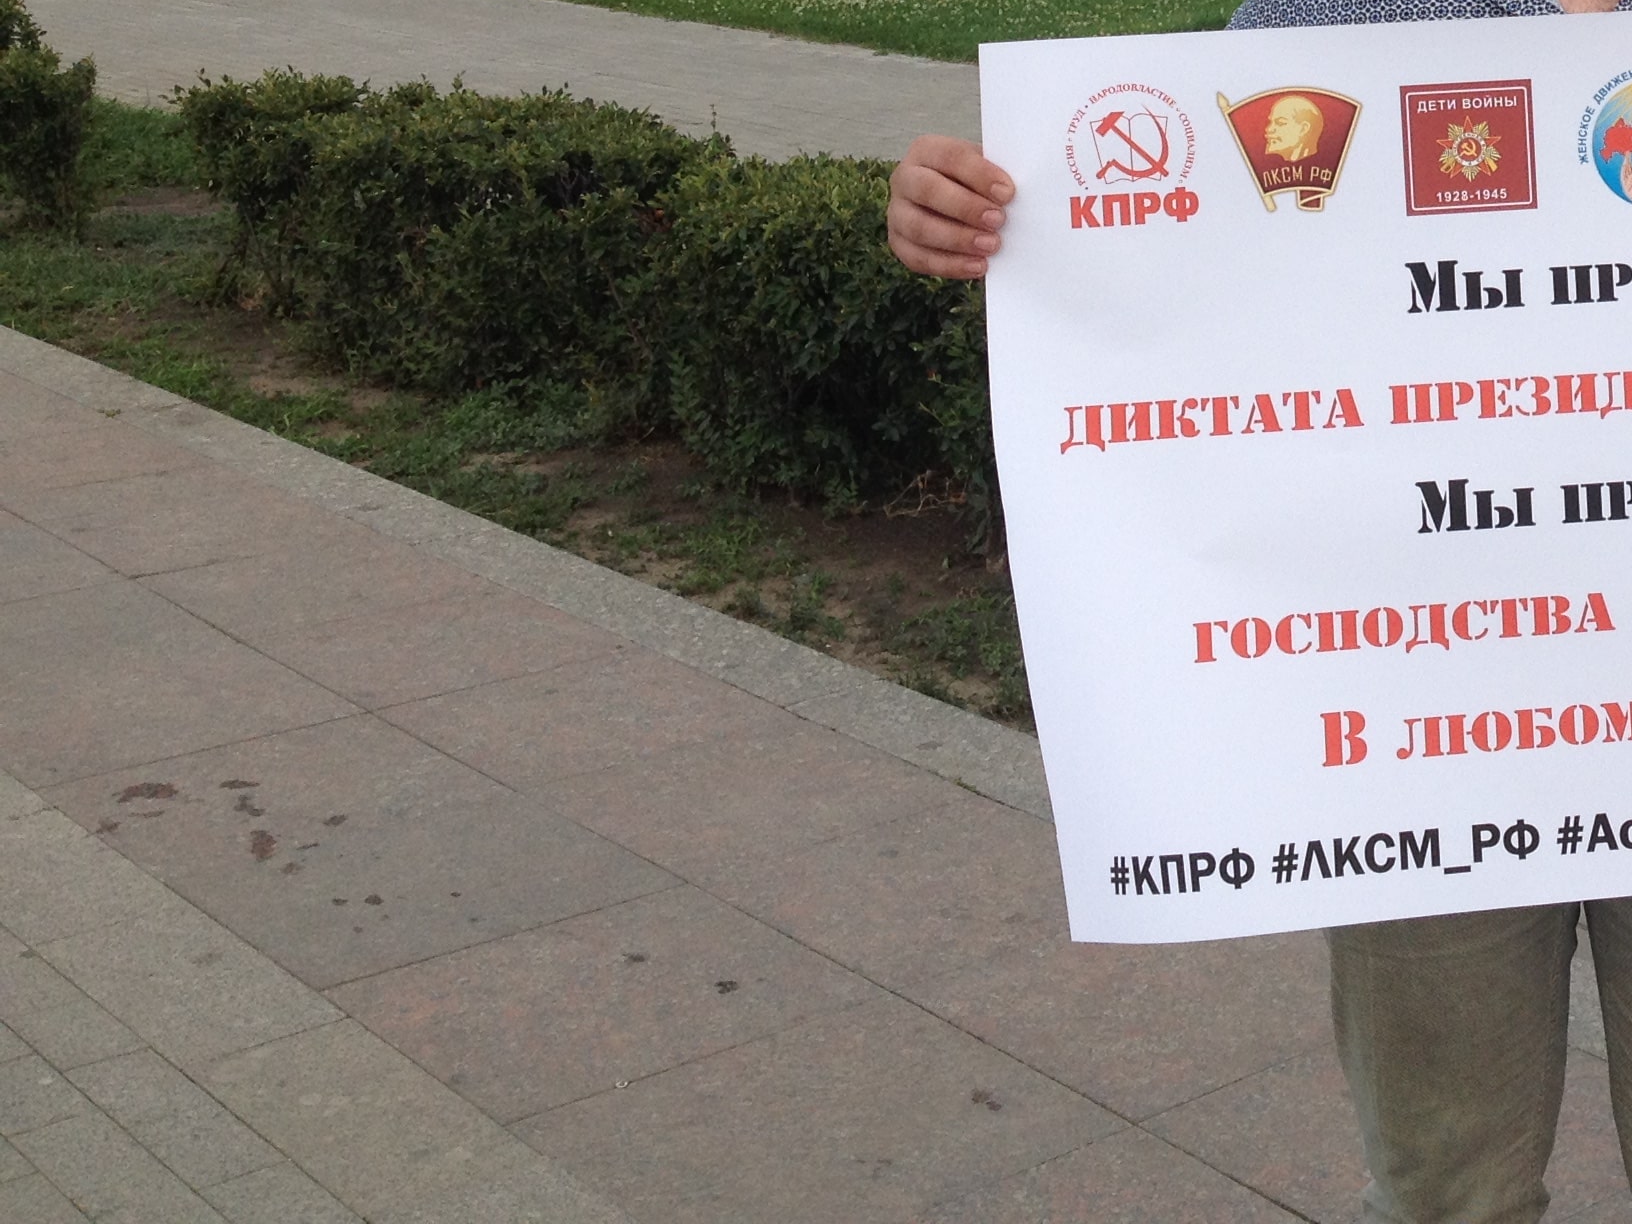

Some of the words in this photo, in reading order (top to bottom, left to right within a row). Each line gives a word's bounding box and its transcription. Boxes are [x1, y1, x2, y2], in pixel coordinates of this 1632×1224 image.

[1416, 99, 1457, 114] ДЕТИ
[1462, 95, 1518, 110] ВОЙНЫ
[1068, 109, 1087, 135] ТРУД
[1577, 105, 1596, 165] ЖЕНСКОЕ
[1262, 165, 1303, 188] ЛКСМ
[1309, 166, 1333, 184] РФ
[1069, 187, 1200, 229] КПРФ
[1435, 187, 1508, 203] 1928-1945
[1319, 710, 1368, 768] В
[1109, 847, 1256, 896] #КПРФ
[1271, 818, 1541, 885] #ЛКСМ_РФ
